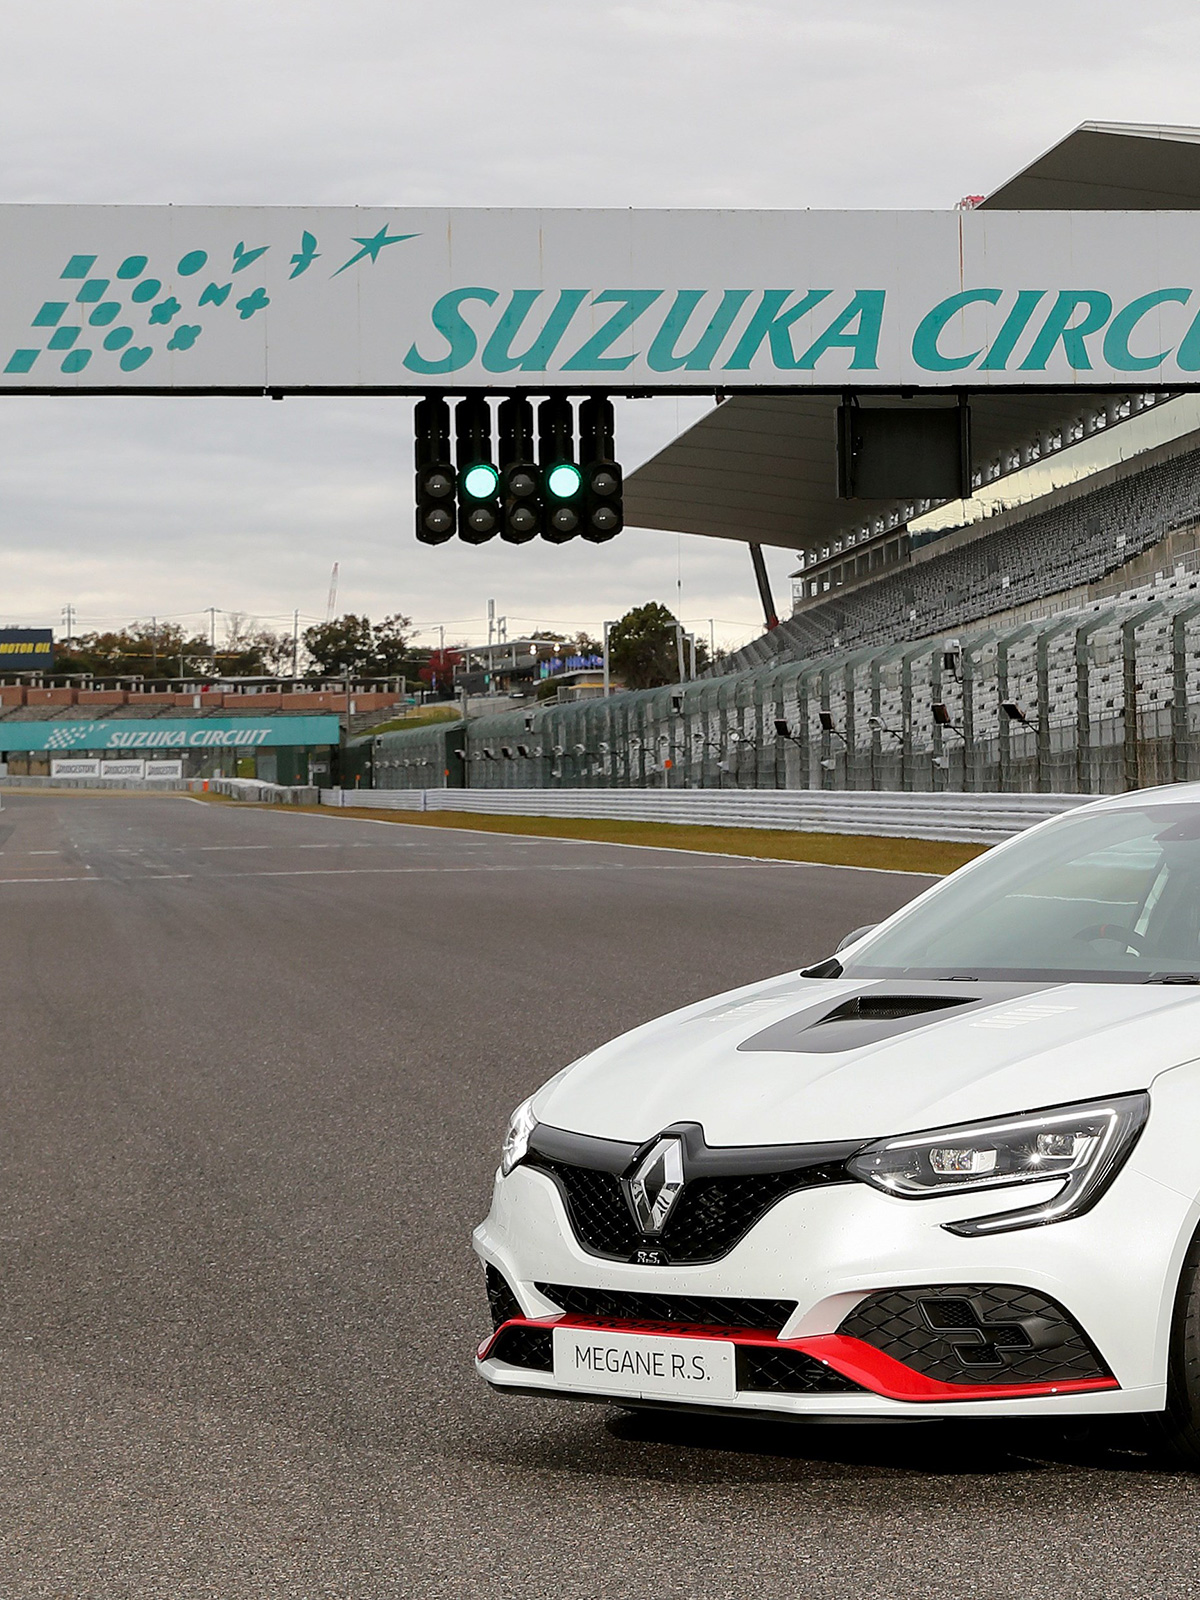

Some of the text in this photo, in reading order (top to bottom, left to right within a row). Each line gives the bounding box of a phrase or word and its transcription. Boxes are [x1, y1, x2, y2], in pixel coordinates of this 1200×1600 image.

[403, 287, 886, 374] SUZUKA
[0, 642, 51, 654] MOTOR OIL
[106, 728, 272, 748] SUZUKA CIRCUIT
[637, 1251, 660, 1264] R.S.
[575, 1345, 711, 1381] MEGANE R.S.
